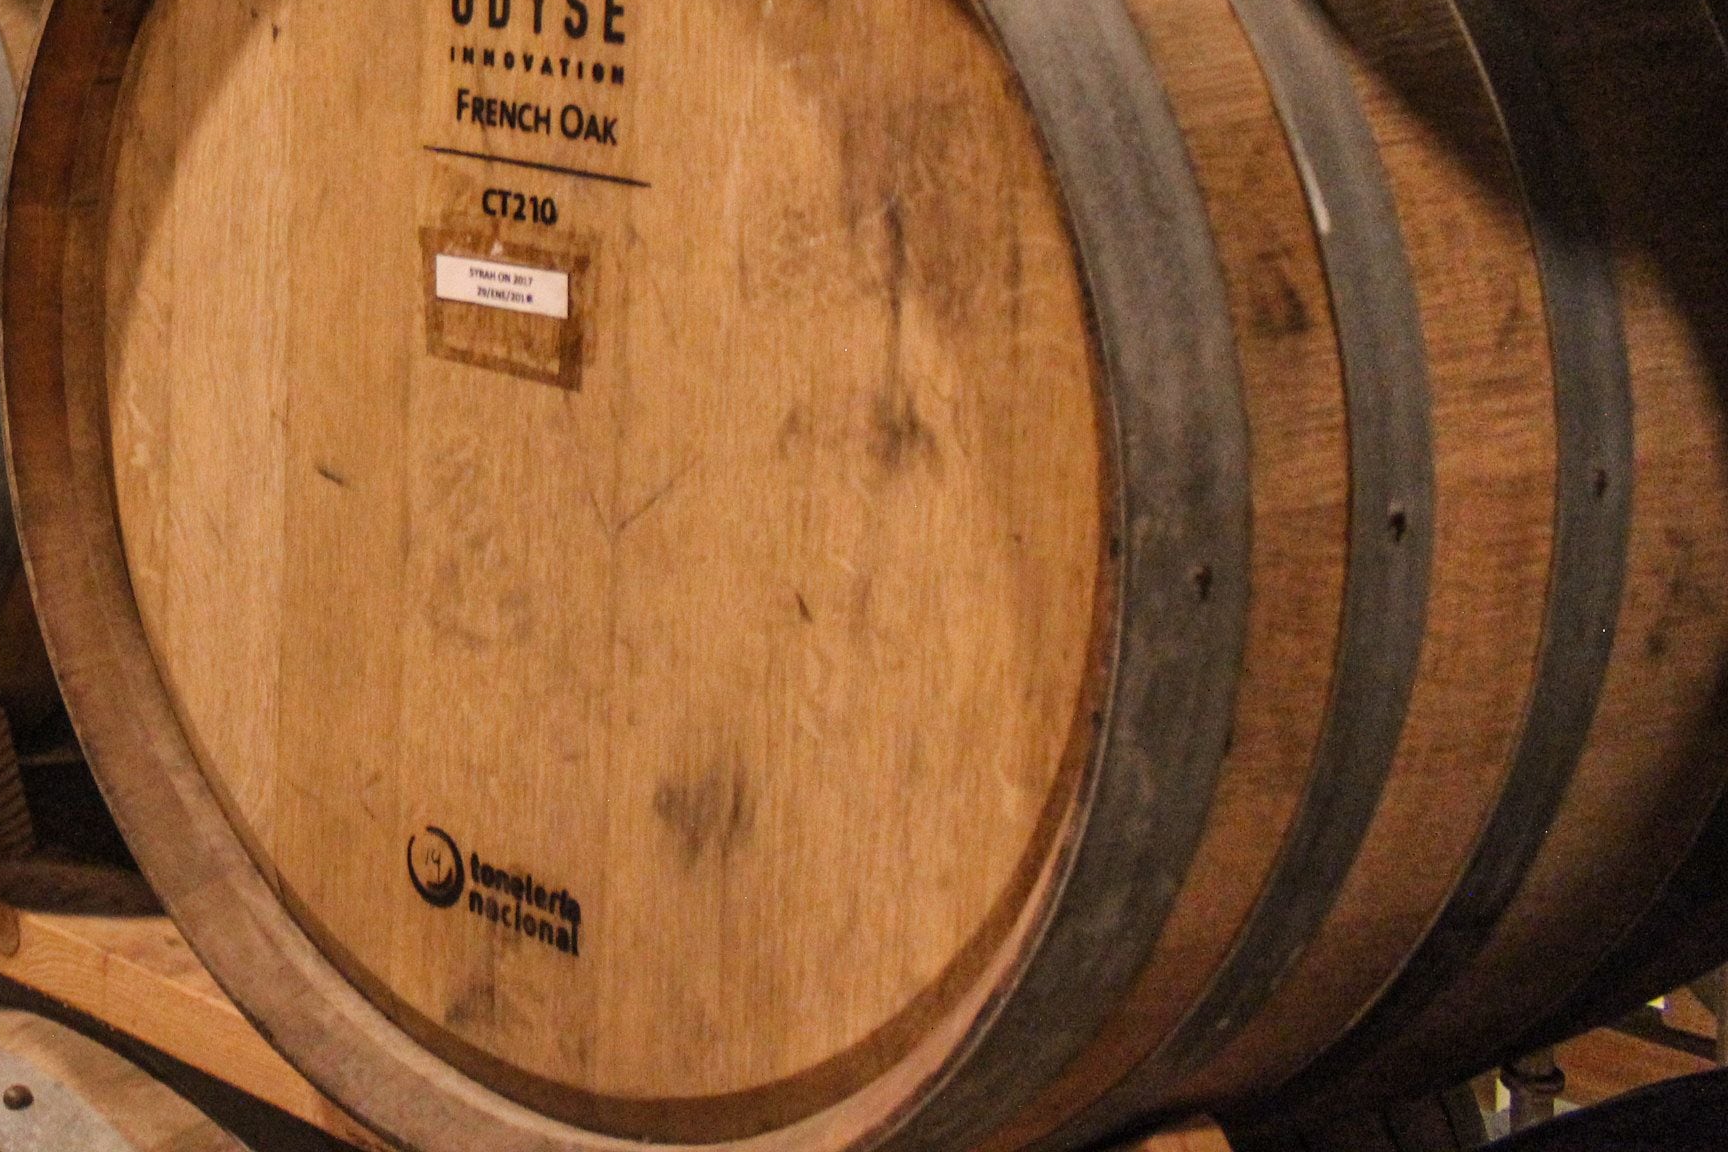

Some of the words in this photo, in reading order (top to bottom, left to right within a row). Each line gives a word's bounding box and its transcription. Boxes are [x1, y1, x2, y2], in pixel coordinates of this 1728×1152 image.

[450, 46, 625, 86] INNOVATION
[455, 87, 552, 136] FRENCH
[559, 103, 618, 147] OAK
[481, 187, 559, 226] CT210
